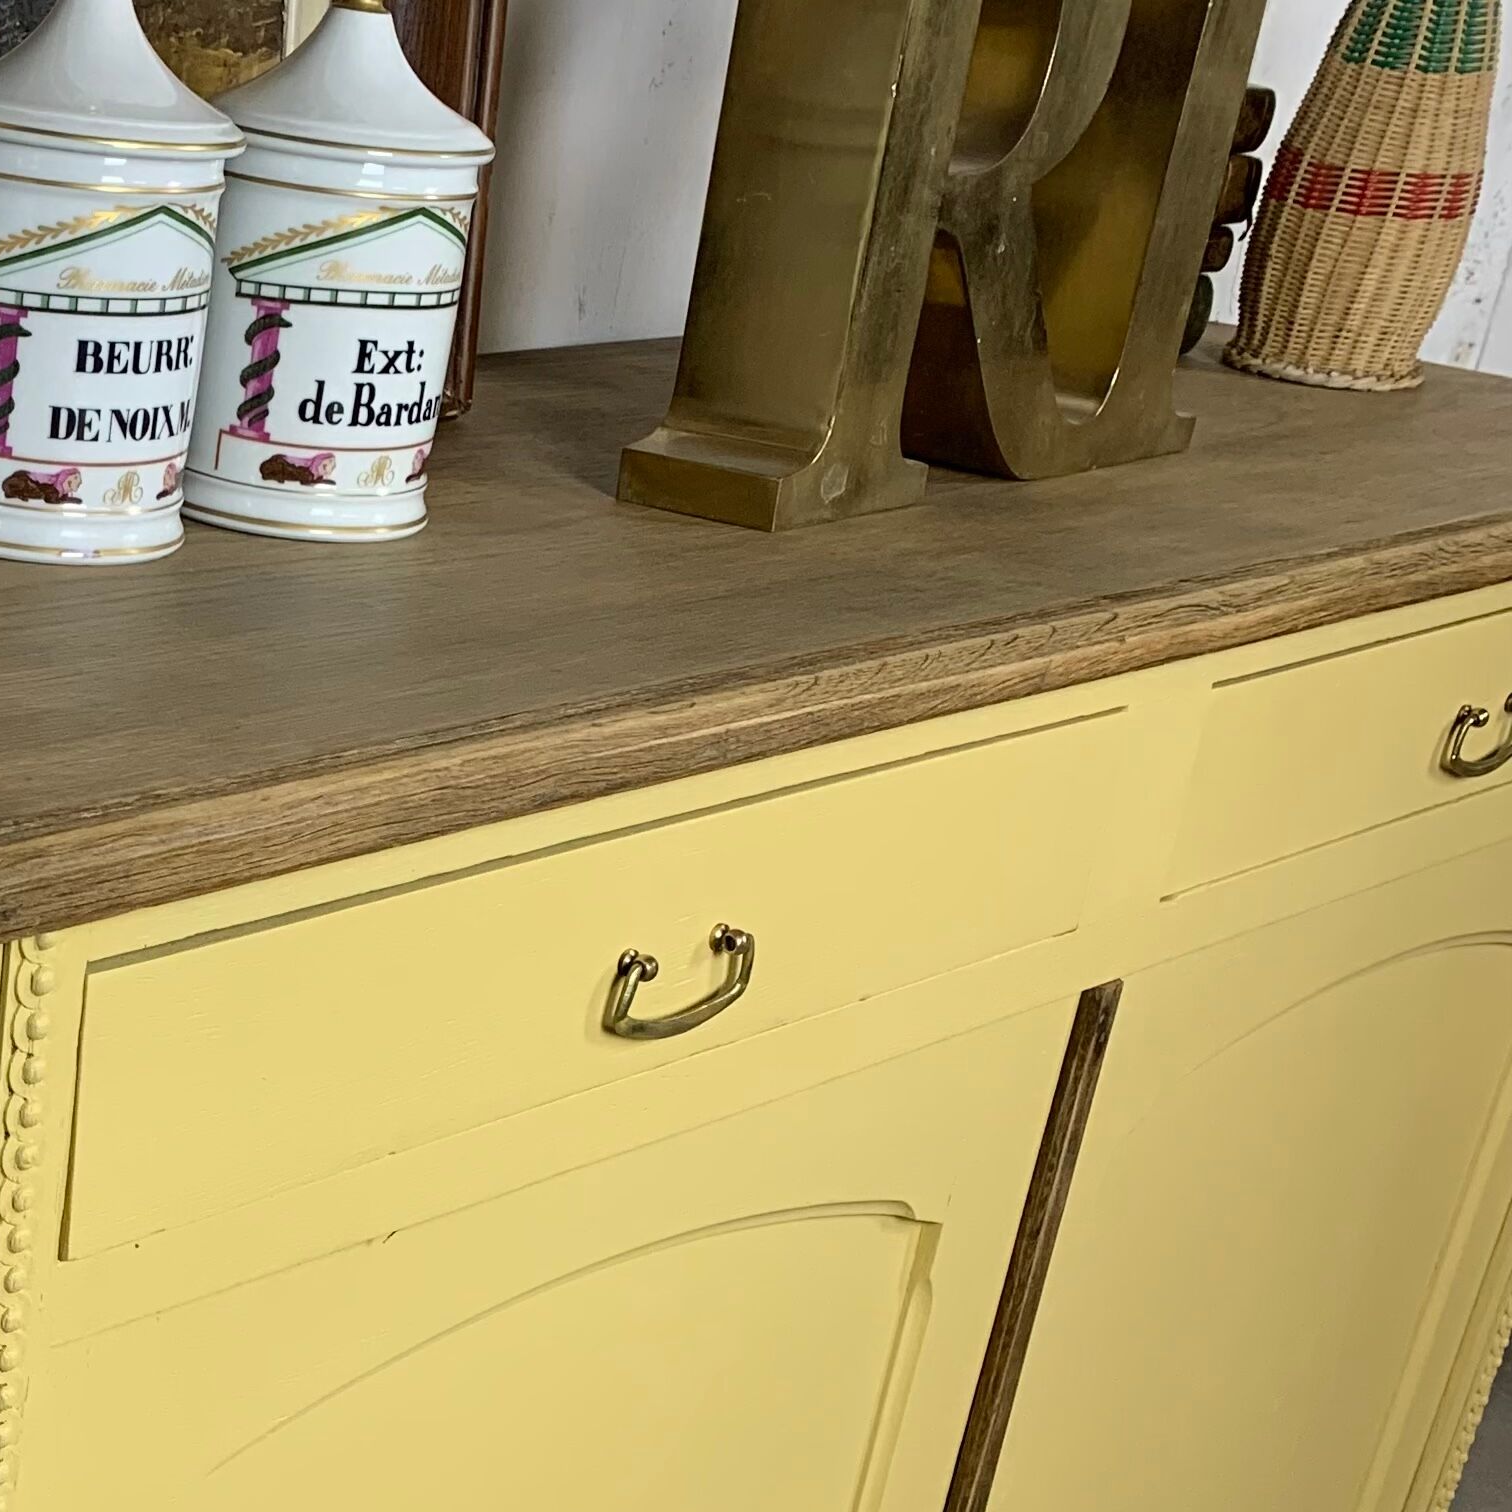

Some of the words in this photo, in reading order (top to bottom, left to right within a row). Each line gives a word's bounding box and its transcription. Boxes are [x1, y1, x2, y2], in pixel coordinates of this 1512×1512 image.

[352, 338, 425, 375] Ext:
[297, 379, 345, 426] de
[47, 404, 101, 443] DE
